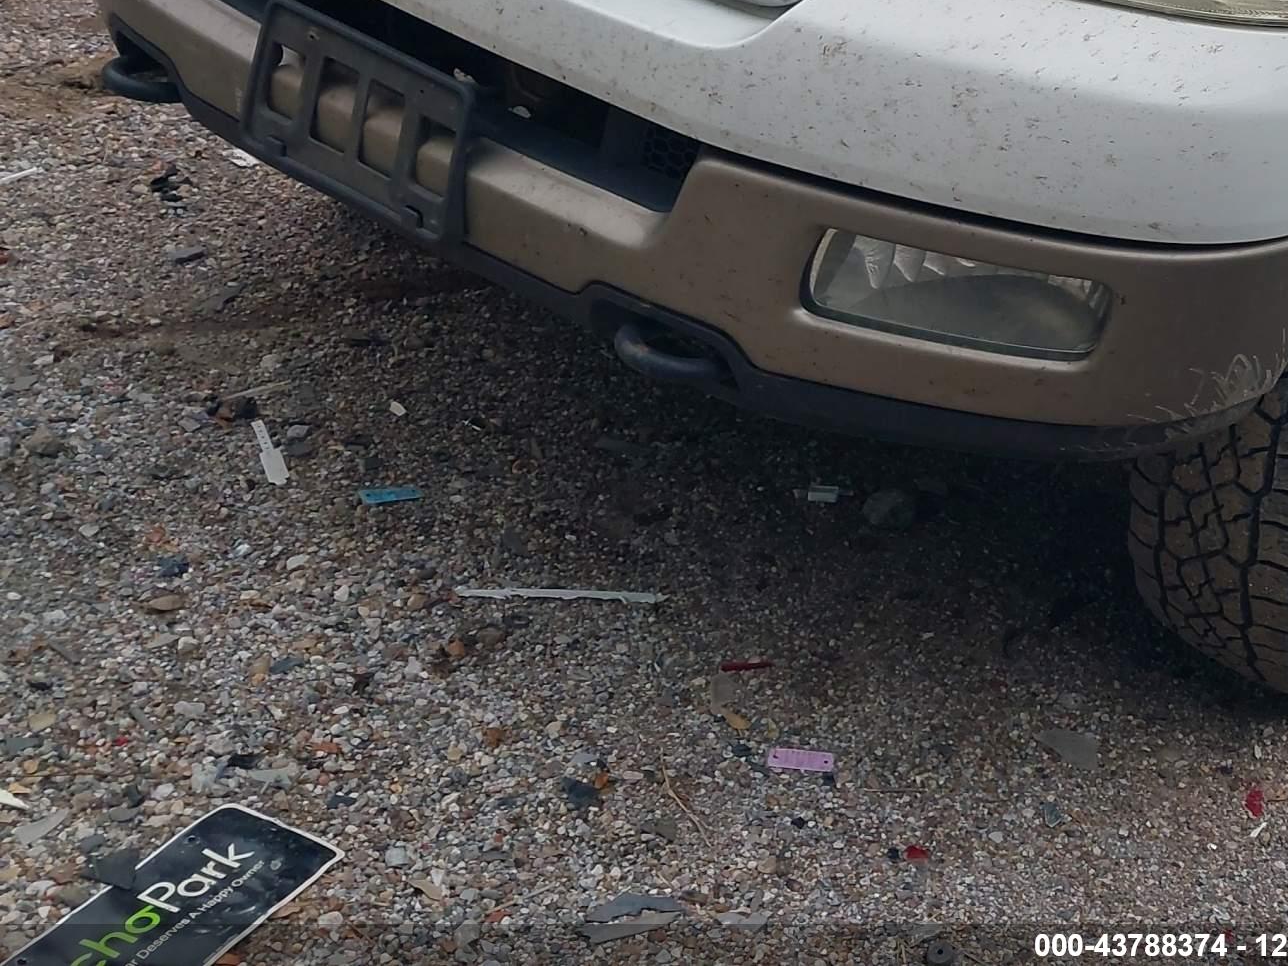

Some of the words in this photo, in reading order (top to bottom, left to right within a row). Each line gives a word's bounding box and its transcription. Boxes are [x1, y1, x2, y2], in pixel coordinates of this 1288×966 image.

[136, 917, 190, 961] Deserves
[200, 884, 235, 913] Happy
[232, 859, 266, 889] Owner
